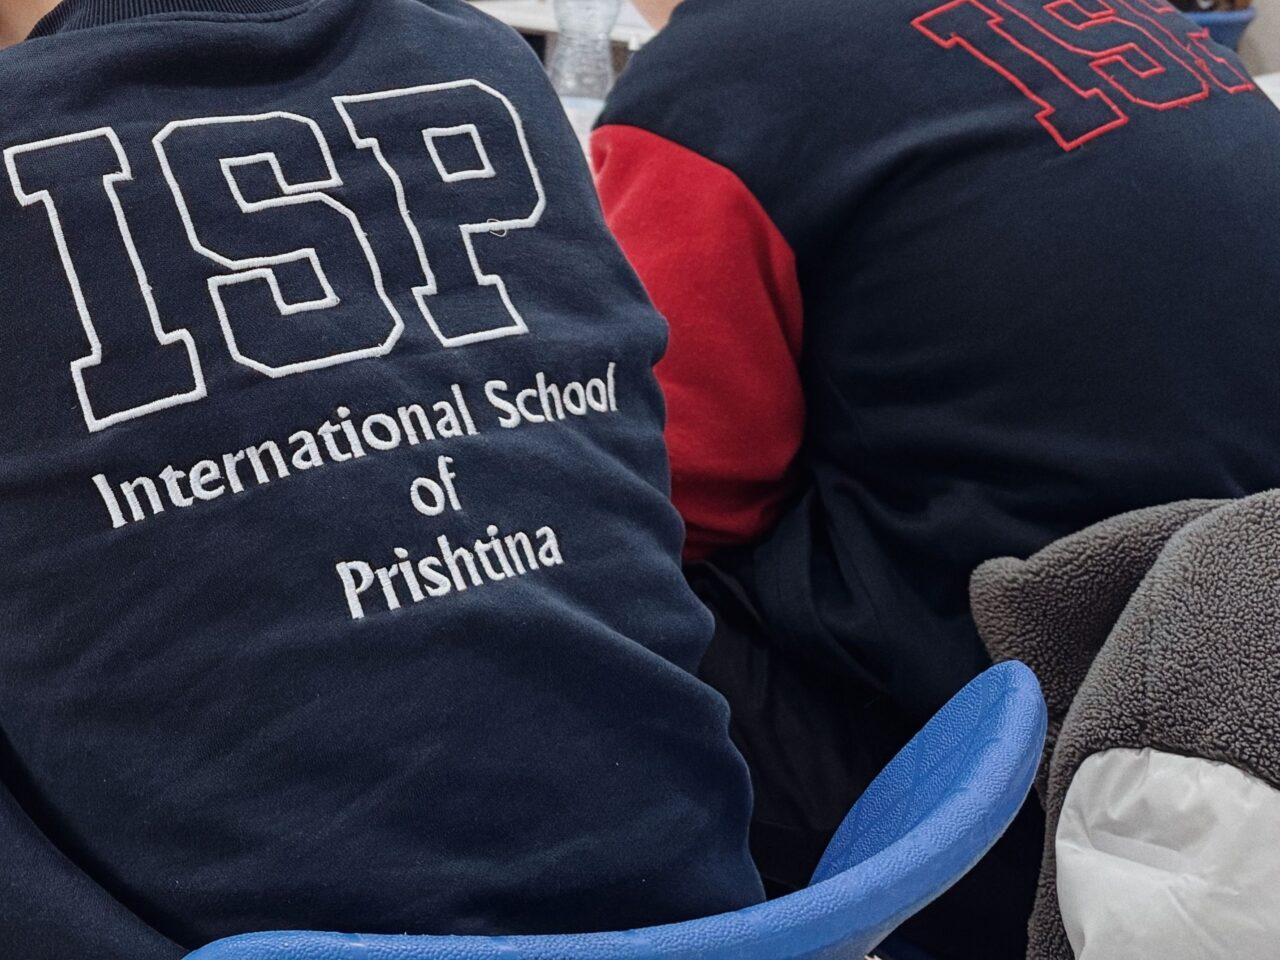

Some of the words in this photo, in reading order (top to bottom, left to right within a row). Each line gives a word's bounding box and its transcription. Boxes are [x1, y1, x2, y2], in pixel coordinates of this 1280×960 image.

[3, 78, 547, 433] ISP
[91, 383, 478, 528] International
[483, 361, 619, 430] School
[409, 455, 462, 517] of
[335, 524, 564, 620] Prishtina
